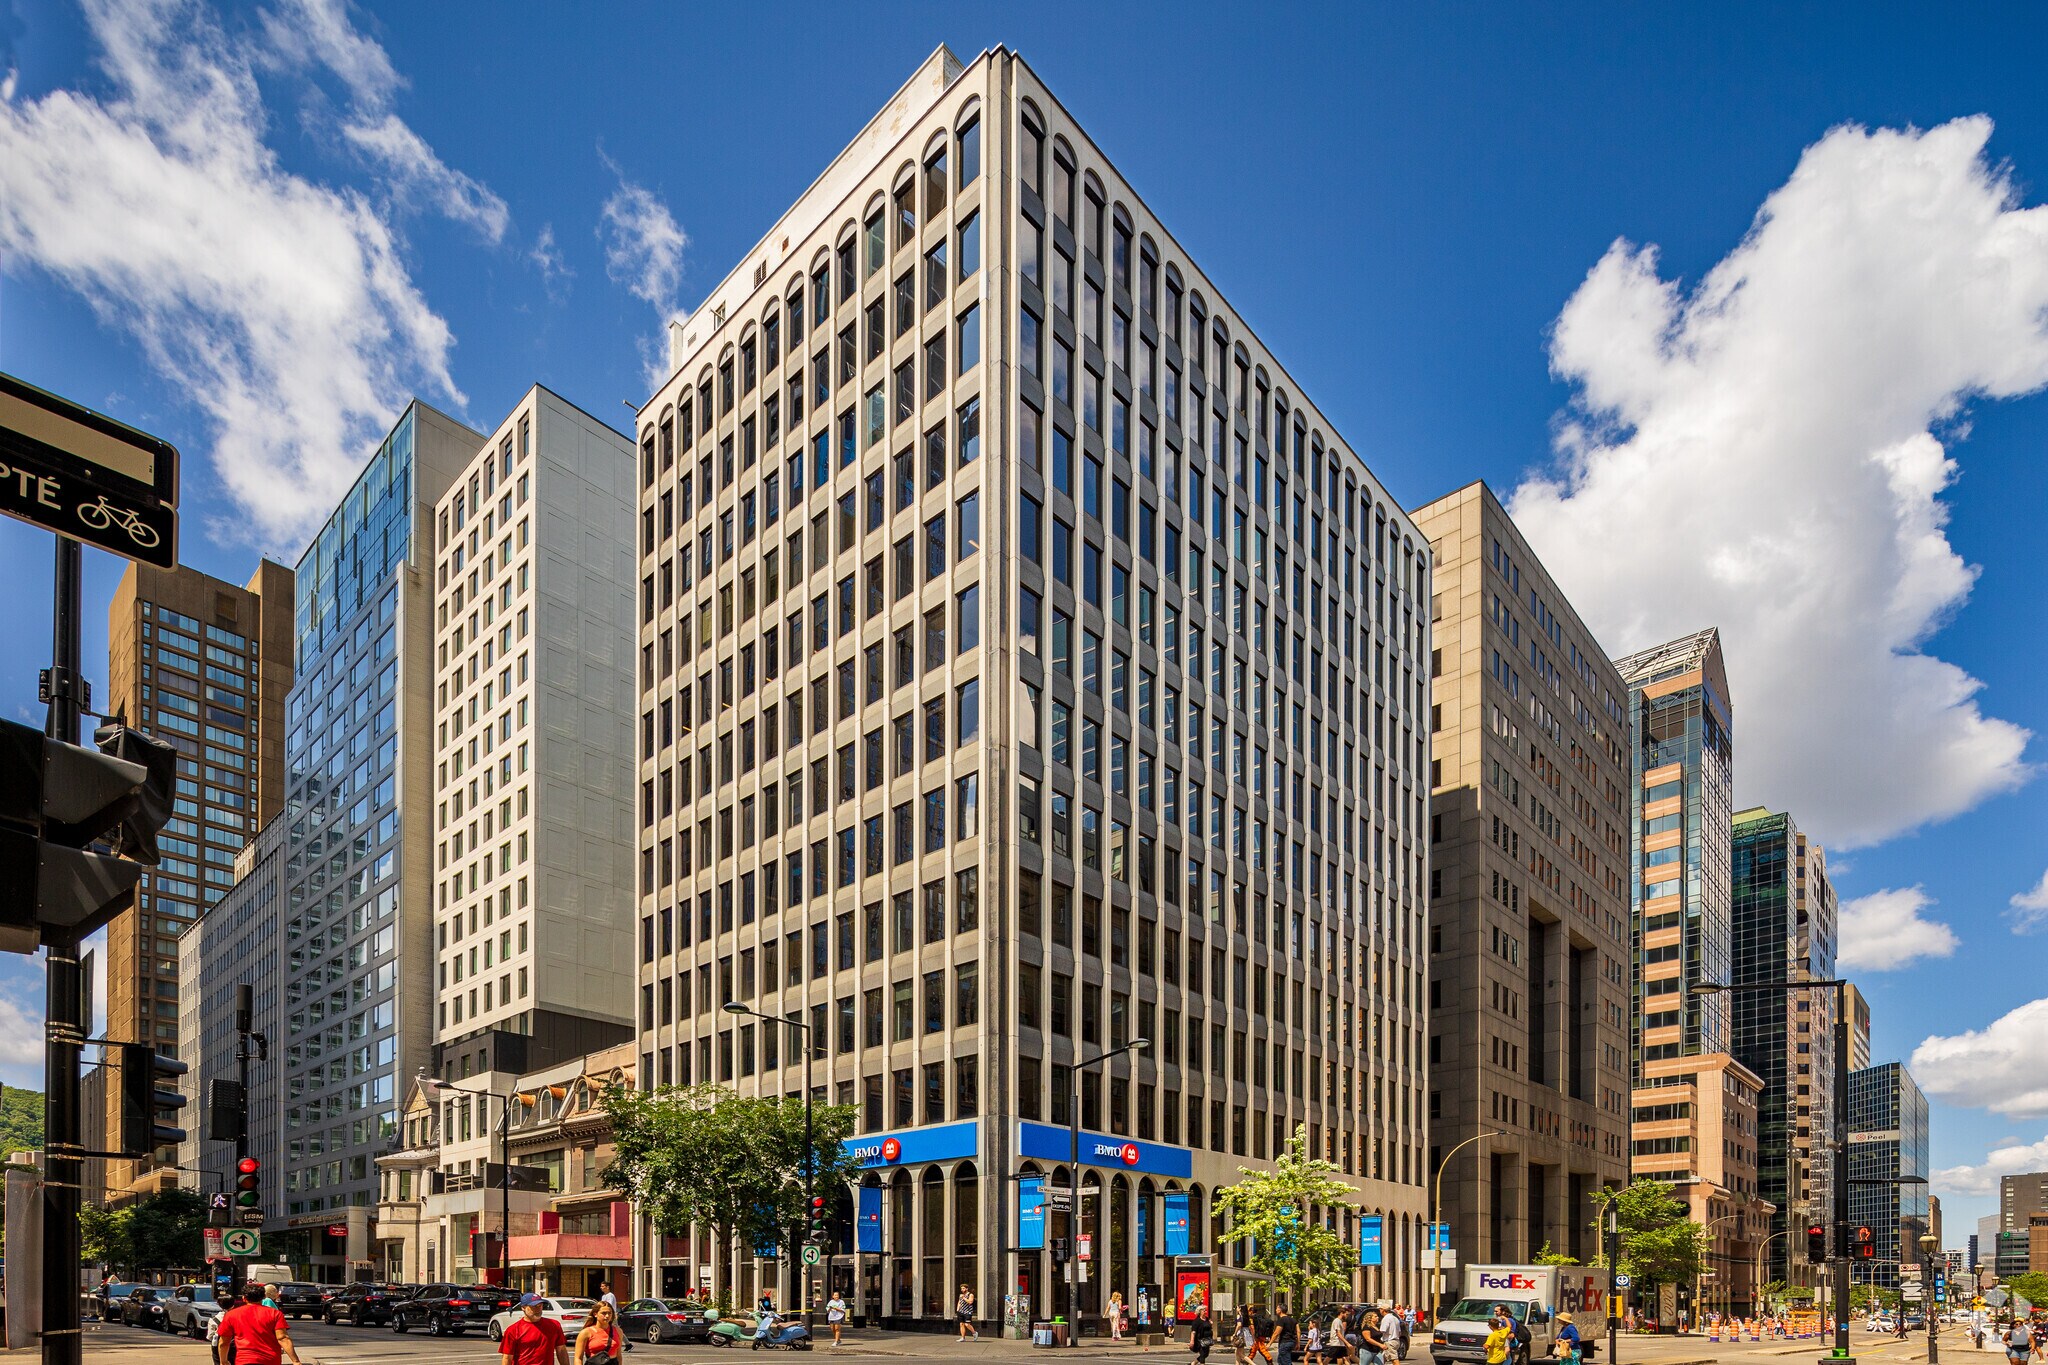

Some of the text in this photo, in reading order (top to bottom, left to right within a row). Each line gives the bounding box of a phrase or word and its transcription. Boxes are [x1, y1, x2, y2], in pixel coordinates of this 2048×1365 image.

[854, 1145, 880, 1159] BMO
[1094, 1143, 1122, 1158] BMO
[1479, 1273, 1536, 1290] FedEx
[1559, 1275, 1603, 1314] FedEx
